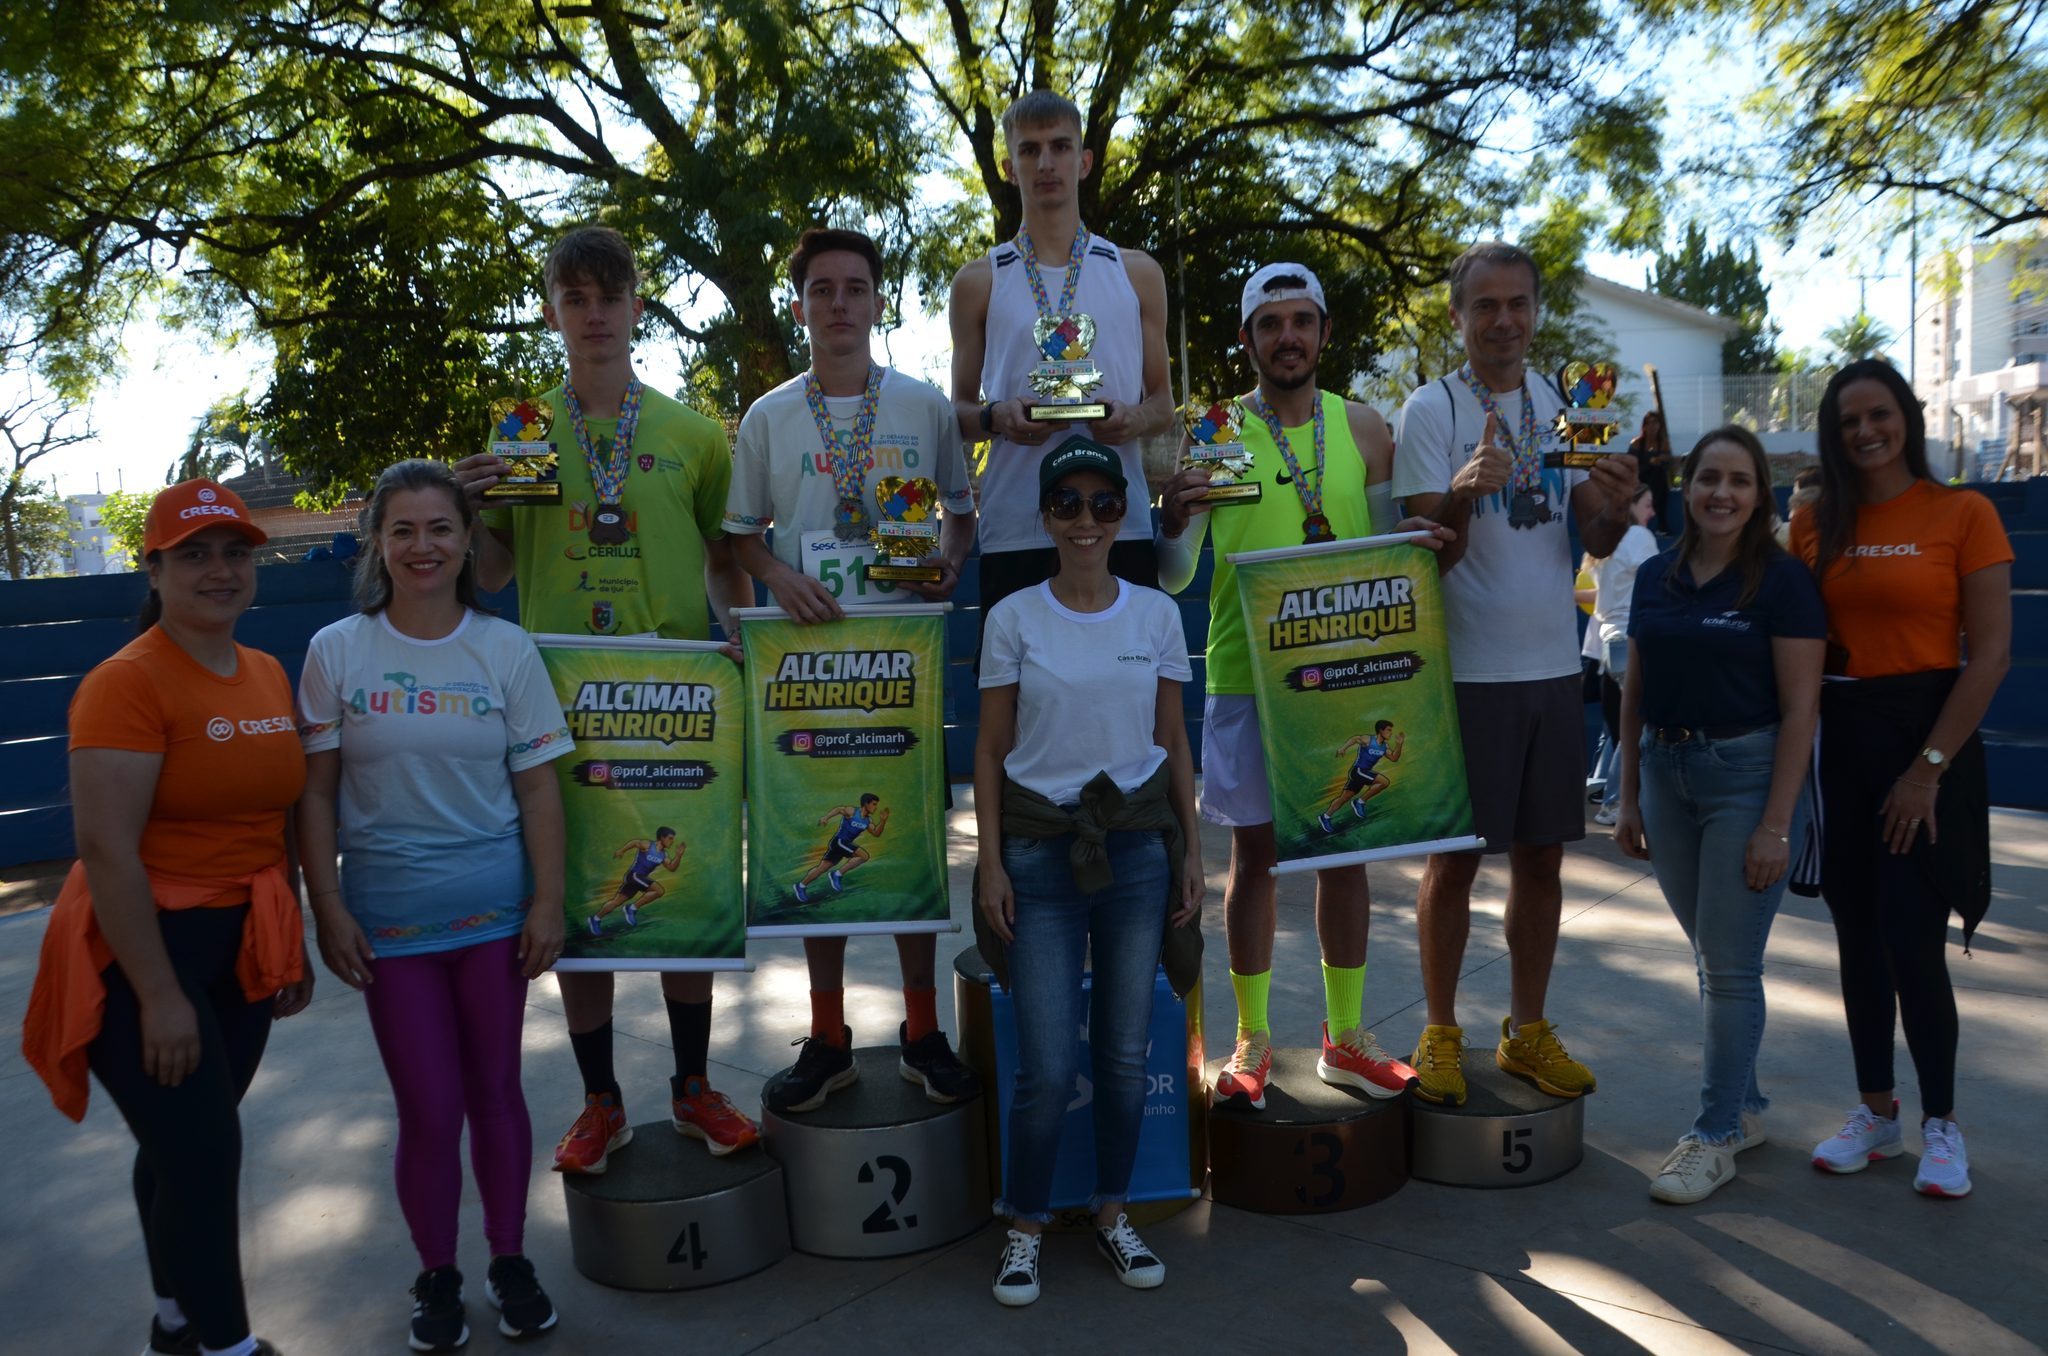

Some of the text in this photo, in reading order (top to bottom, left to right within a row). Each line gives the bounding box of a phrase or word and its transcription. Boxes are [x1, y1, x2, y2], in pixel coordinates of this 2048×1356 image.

[801, 446, 920, 477] Aumo
[1052, 449, 1108, 467] Casa Branca
[180, 505, 240, 520] CRESOL
[588, 546, 641, 558] CERILUZ
[1844, 543, 1922, 557] CRESOL
[1280, 577, 1411, 621] ALCIMAR
[1273, 605, 1413, 647] HENRIQUE
[778, 652, 912, 681] ALCIMAR
[1323, 656, 1412, 681] @prof_alcimarh
[350, 688, 491, 716] Autismo
[575, 683, 713, 712] ALCIMAR
[768, 680, 912, 710] HENRIQUE
[567, 712, 712, 741] HENRIQUE
[814, 732, 905, 747] @prof_alcimarh
[611, 764, 704, 779] @prof_alcimarh
[1146, 1073, 1175, 1096] OR
[1144, 1104, 1176, 1117] tinho
[1501, 1127, 1533, 1175] 5
[1294, 1132, 1347, 1207] 3
[857, 1155, 918, 1234] 2
[667, 1222, 708, 1271] 4
